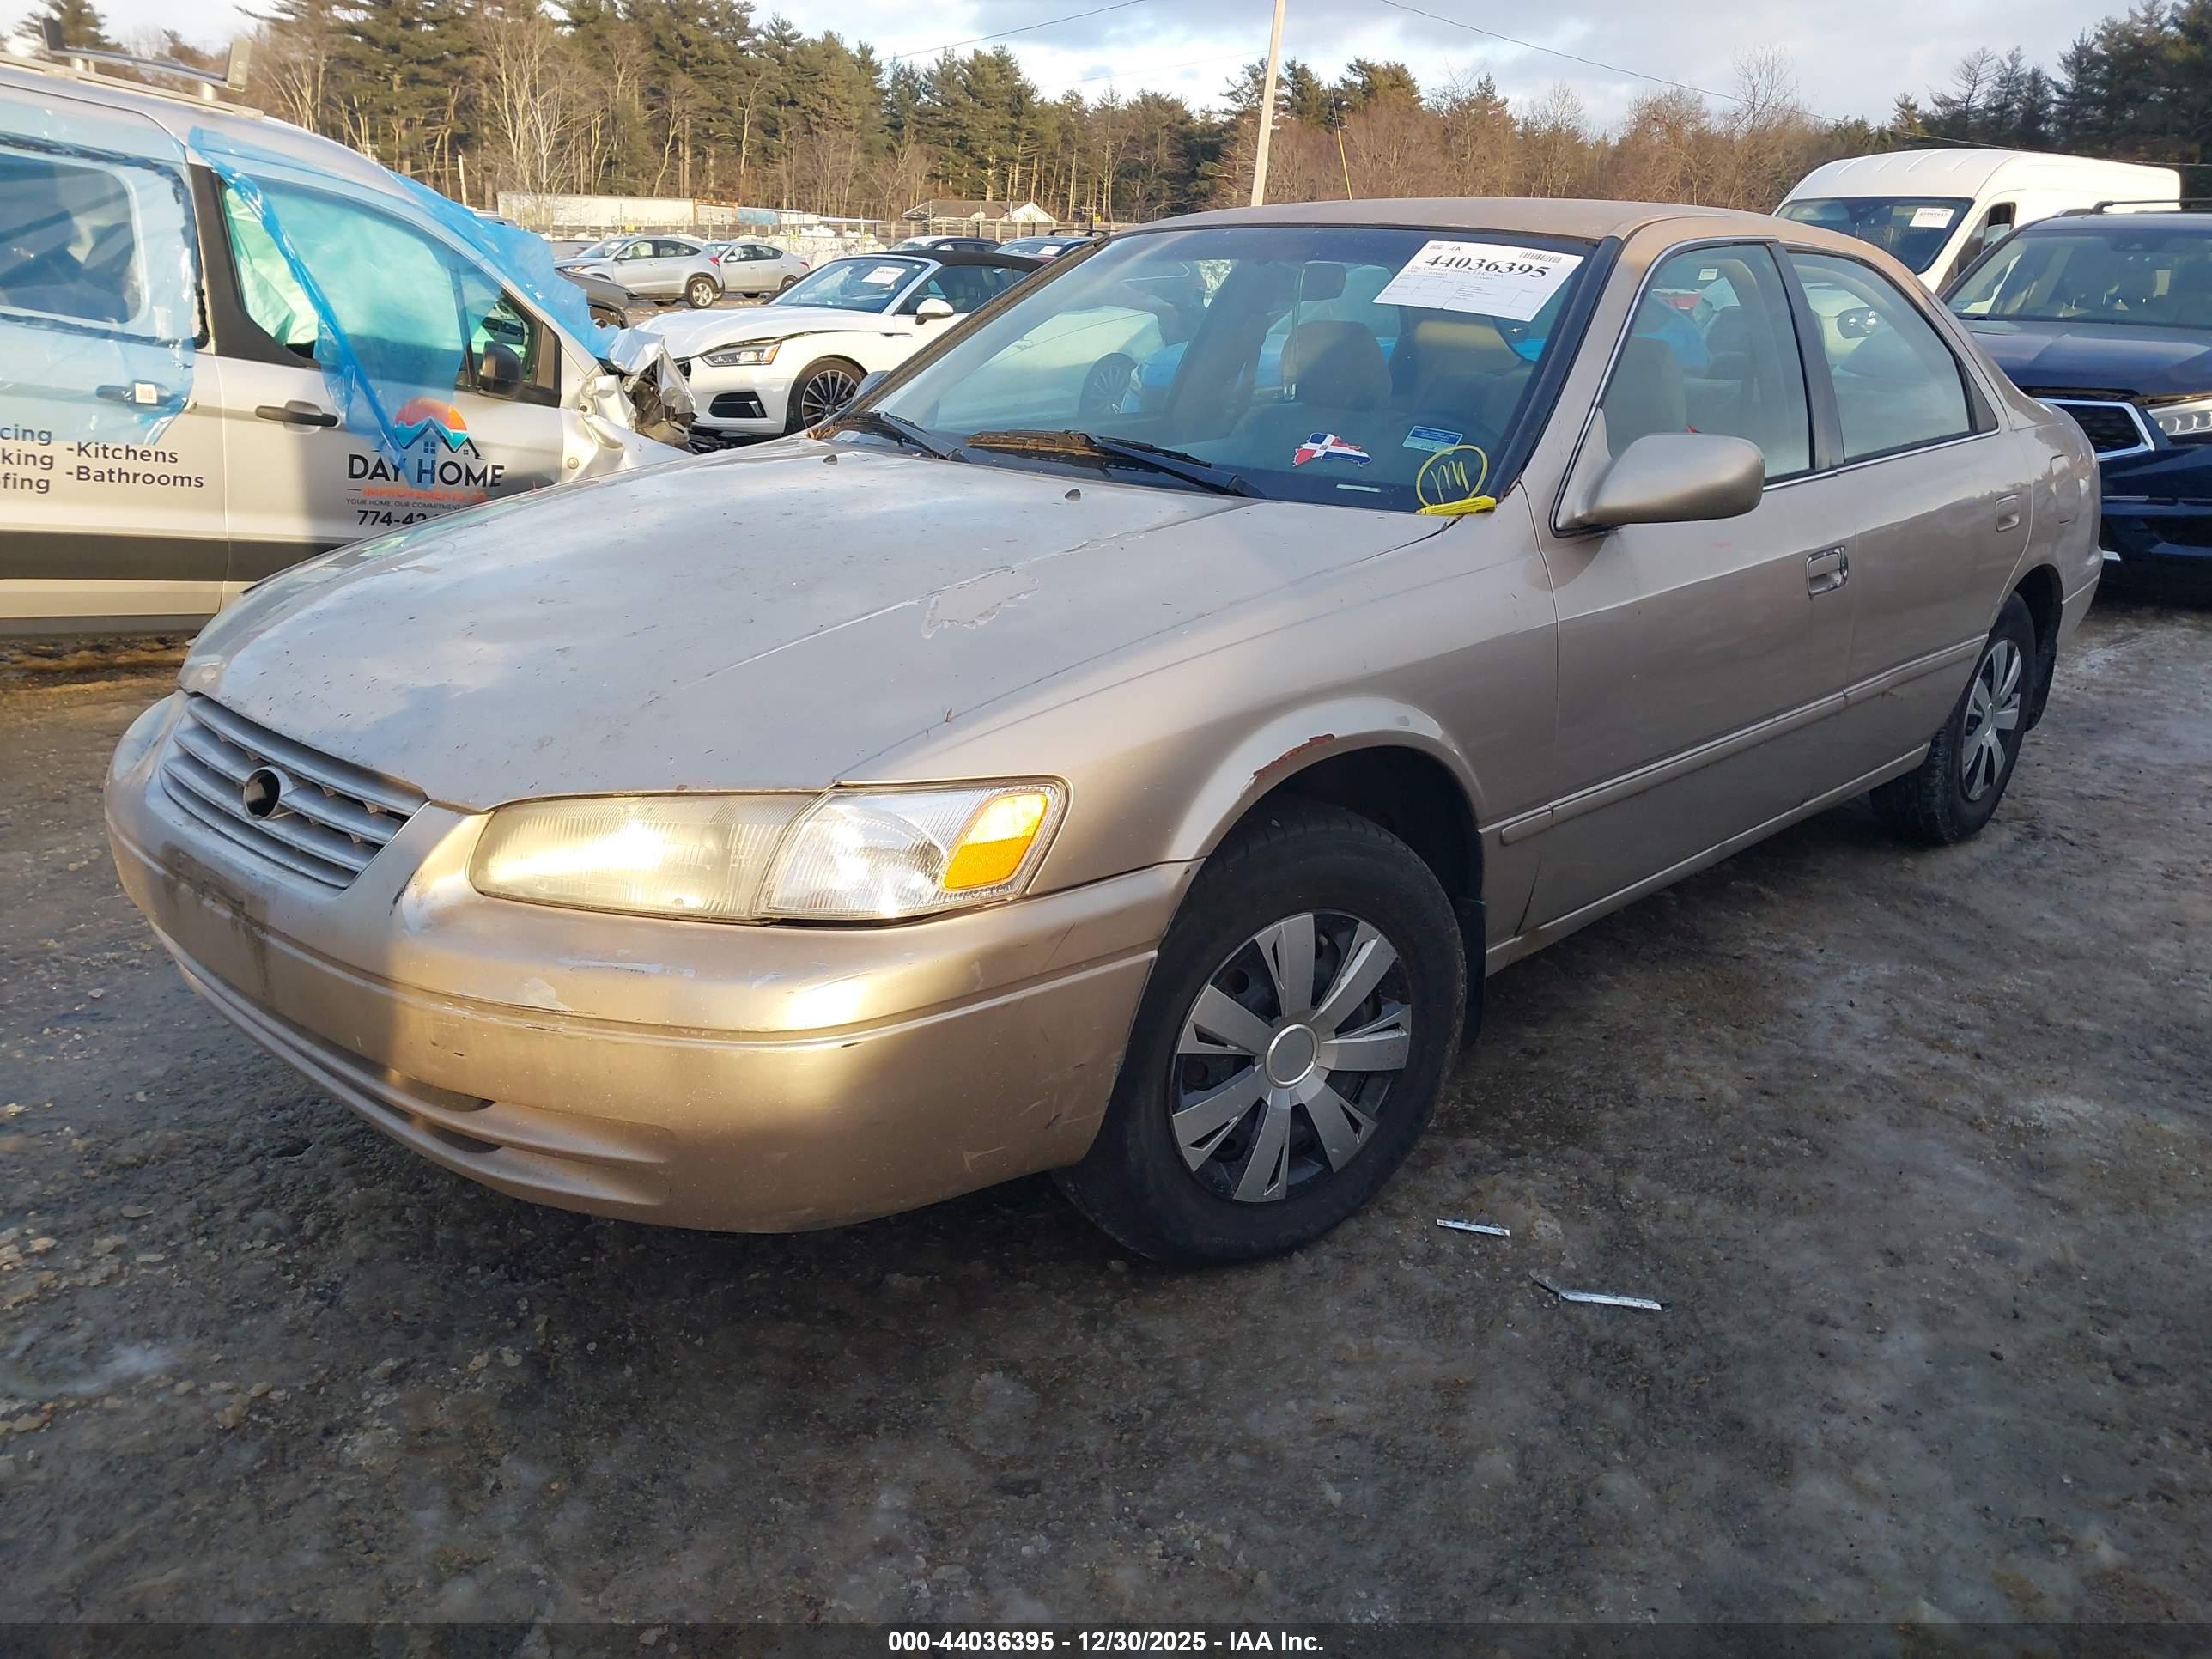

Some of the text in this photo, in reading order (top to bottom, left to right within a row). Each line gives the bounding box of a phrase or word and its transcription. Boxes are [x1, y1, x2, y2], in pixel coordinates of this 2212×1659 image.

[1424, 255, 1551, 278] 44036395
[2, 448, 54, 471] king
[66, 441, 179, 464] -Kitchens
[65, 465, 204, 489] -Bathrooms
[348, 453, 505, 488] DAY HOME
[0, 473, 50, 494] fing
[412, 501, 460, 510] COMMITMENT
